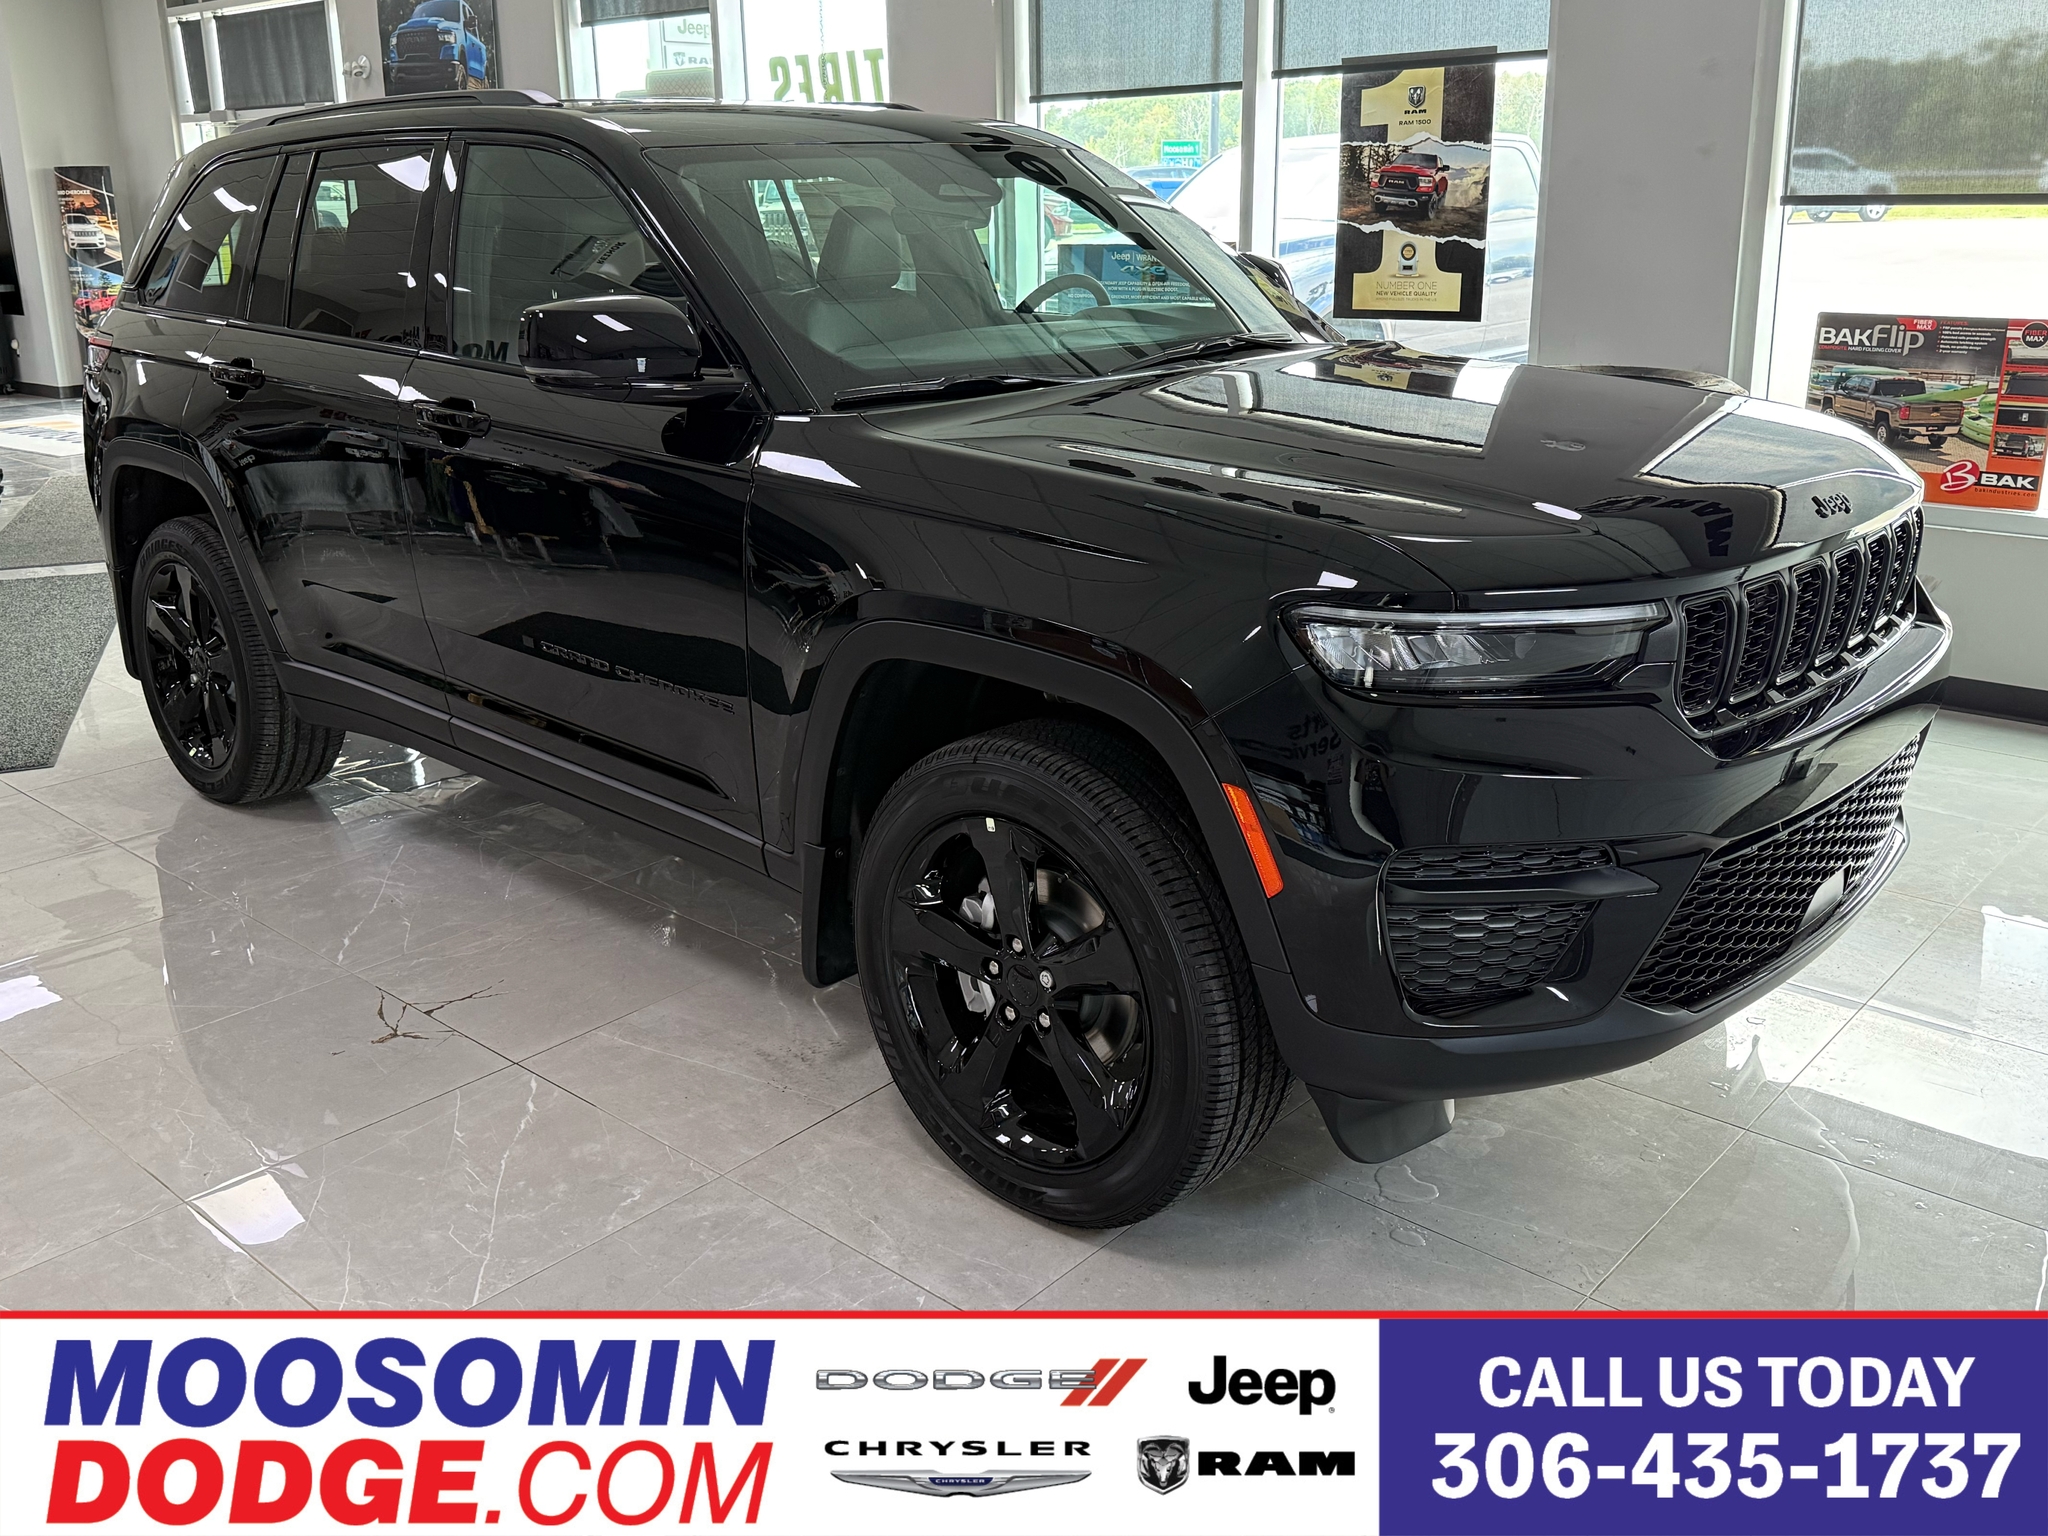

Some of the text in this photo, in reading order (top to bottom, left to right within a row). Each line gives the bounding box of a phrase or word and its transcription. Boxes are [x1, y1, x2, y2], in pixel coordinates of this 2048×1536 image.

[688, 56, 712, 65] RA
[1111, 251, 1131, 263] Jeep
[1376, 281, 1437, 290] NUMBER ONE
[1818, 324, 1925, 357] BAKFlip
[1980, 473, 2035, 489] BAK
[1811, 494, 1852, 518] Jeep
[540, 640, 735, 715] GRAND CHEROKEE
